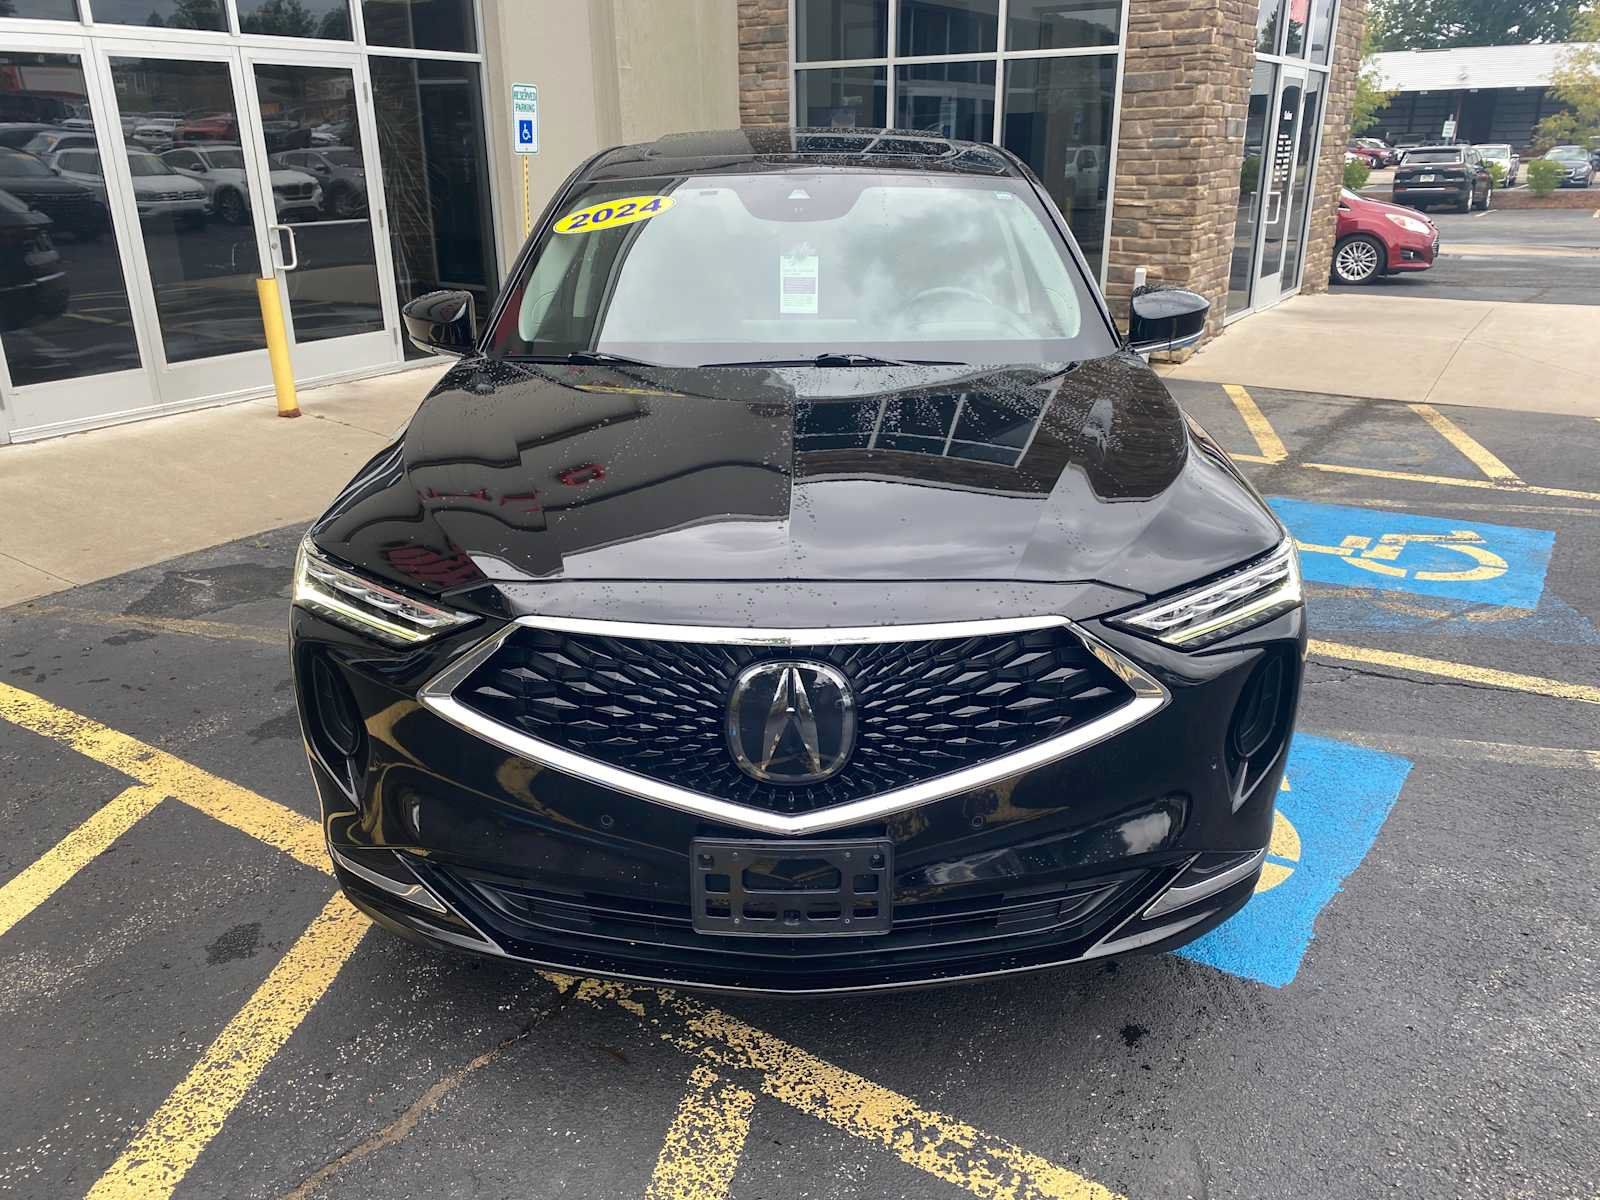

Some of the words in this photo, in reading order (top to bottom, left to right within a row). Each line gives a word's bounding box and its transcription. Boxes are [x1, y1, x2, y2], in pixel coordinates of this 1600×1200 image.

[512, 91, 537, 101] RESERVED
[515, 103, 536, 113] PARKING
[566, 198, 662, 231] 2024
